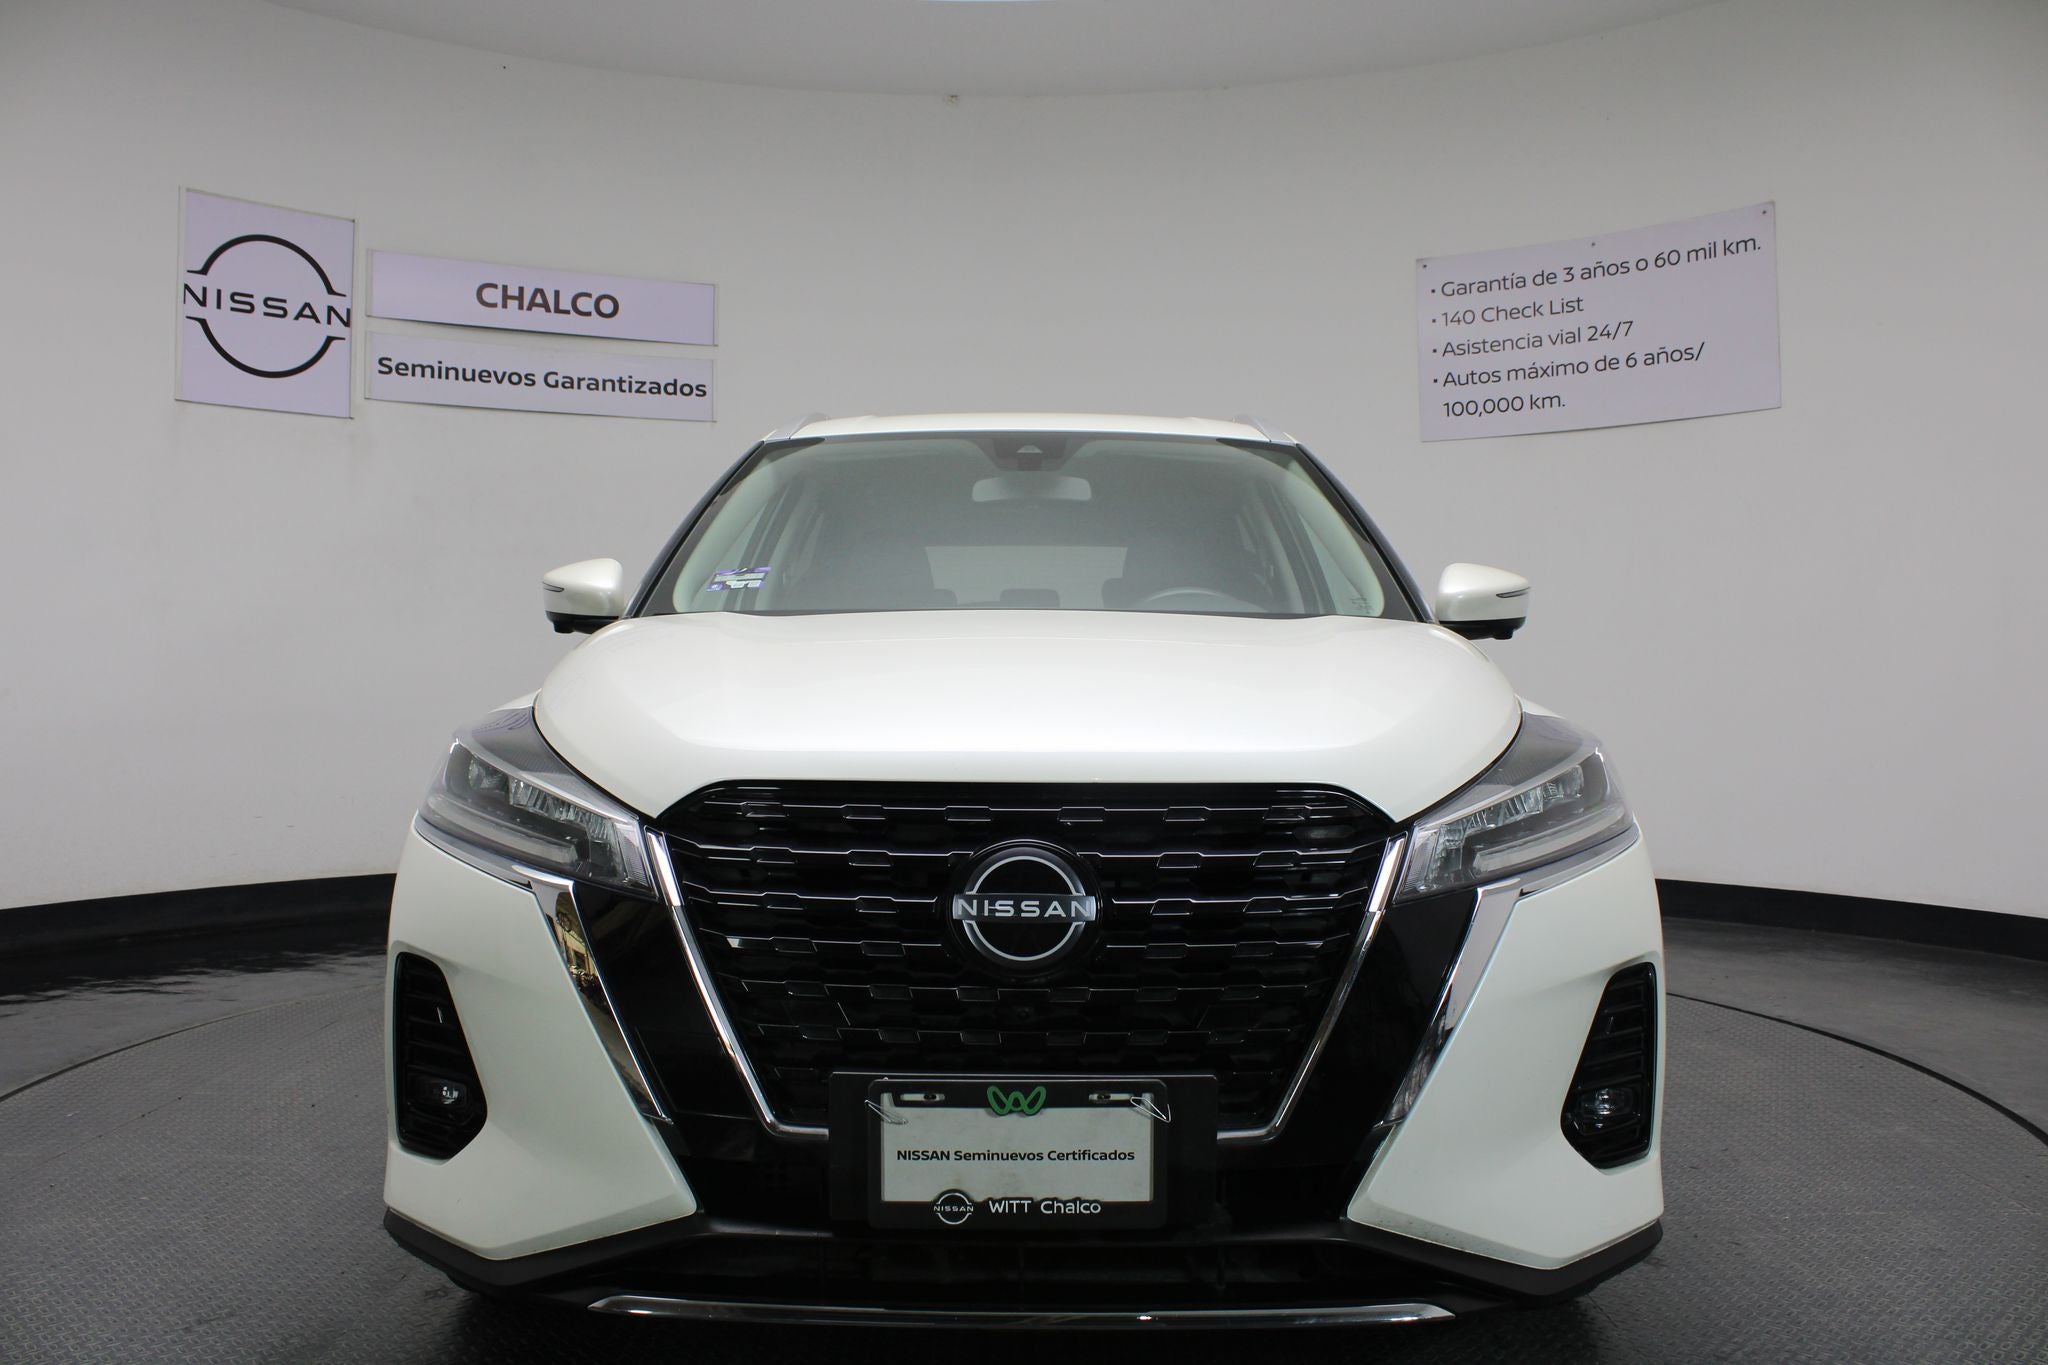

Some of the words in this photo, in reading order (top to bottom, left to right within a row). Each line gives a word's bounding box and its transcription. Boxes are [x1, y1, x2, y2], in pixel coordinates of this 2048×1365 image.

[1441, 273, 1527, 297] Garantía
[1532, 269, 1558, 287] de
[1563, 267, 1574, 282] 3
[1580, 261, 1631, 280] años
[1635, 258, 1649, 271] o
[1654, 250, 1681, 268] 60
[1686, 241, 1718, 262] mil
[1723, 237, 1762, 255] km.
[183, 283, 351, 328] NISSAN
[475, 283, 620, 318] CHALCO
[1442, 310, 1476, 327] 140
[1481, 301, 1544, 323] Check
[1549, 297, 1584, 315] List
[1442, 333, 1543, 357] Asistencia
[1548, 327, 1582, 345] vial
[1587, 321, 1634, 342] 24/7
[377, 356, 536, 388] Seminuevos
[543, 372, 708, 399] Garantizados
[1443, 369, 1501, 387] Autos
[1506, 359, 1589, 382] máximo
[1594, 354, 1620, 372] de
[1625, 353, 1638, 368] 6
[1643, 342, 1705, 366] años/
[1443, 396, 1524, 418] 100,000
[1529, 393, 1566, 409] km.
[957, 898, 1092, 918] NISSAN
[897, 1149, 950, 1161] NISSAN
[954, 1149, 1044, 1161] Seminuevos
[1047, 1149, 1135, 1161] Certificados
[933, 1204, 974, 1212] NISSAN
[988, 1199, 1032, 1214] WITT
[1040, 1200, 1101, 1214] Chalco
